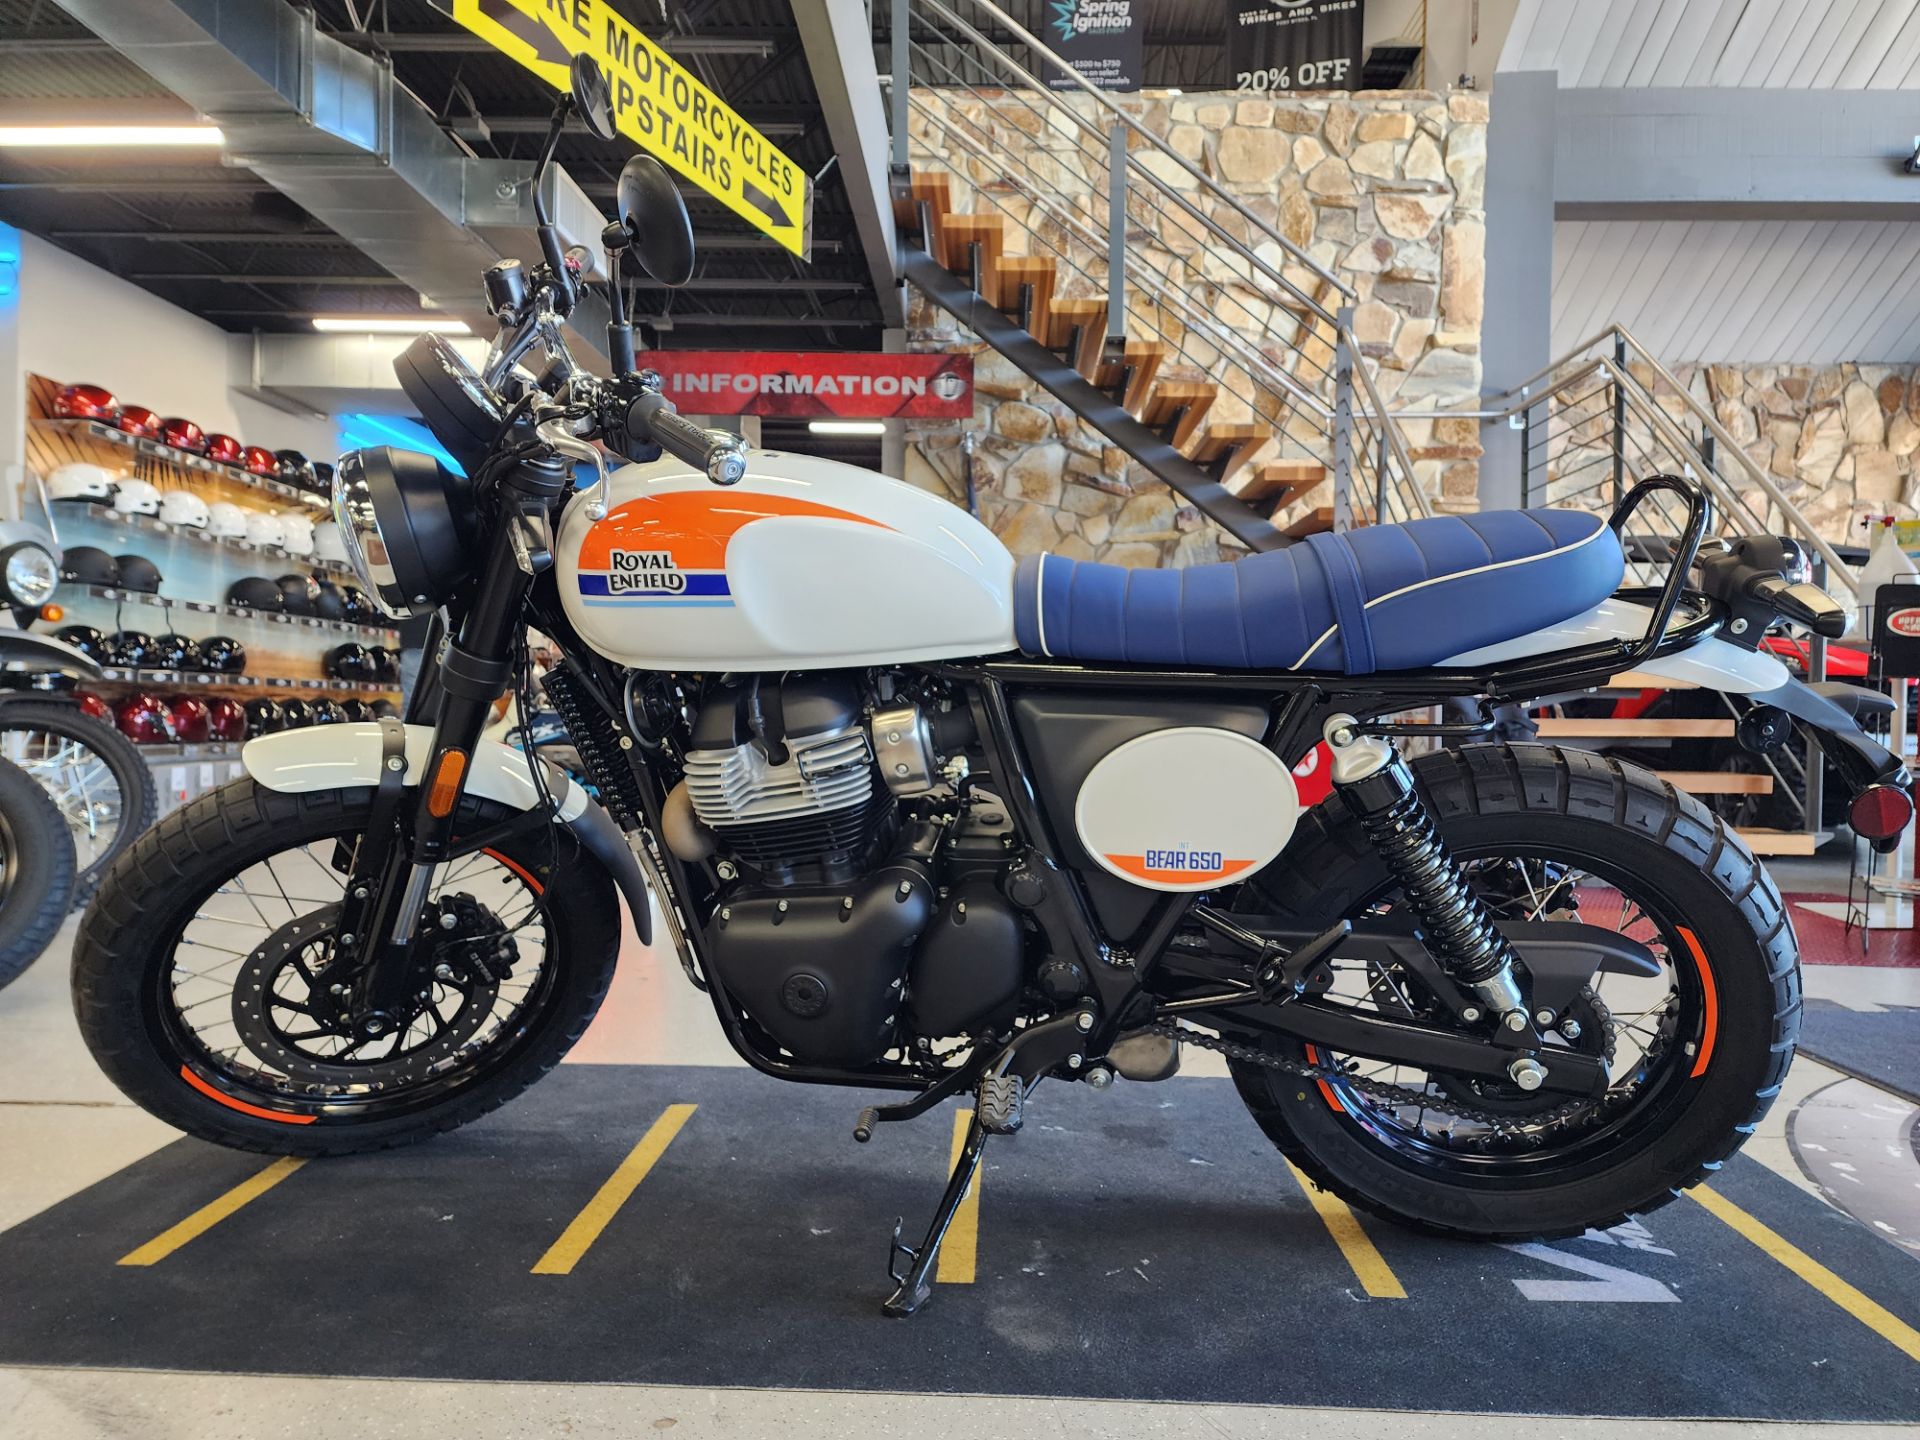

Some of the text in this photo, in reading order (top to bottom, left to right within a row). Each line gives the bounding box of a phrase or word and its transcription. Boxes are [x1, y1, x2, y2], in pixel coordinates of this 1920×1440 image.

[1079, 0, 1130, 16] Spring
[1288, 7, 1314, 18] AND
[1320, 0, 1357, 13] BIKES
[1073, 13, 1132, 33] Ignition
[1237, 58, 1351, 90] 20% OFF
[606, 17, 793, 196] MOTORCYCLES
[672, 373, 926, 396] INFORMATION
[612, 552, 674, 572] ROYAL
[609, 573, 684, 592] ENFIELD
[1146, 849, 1222, 870] BEAR 650
